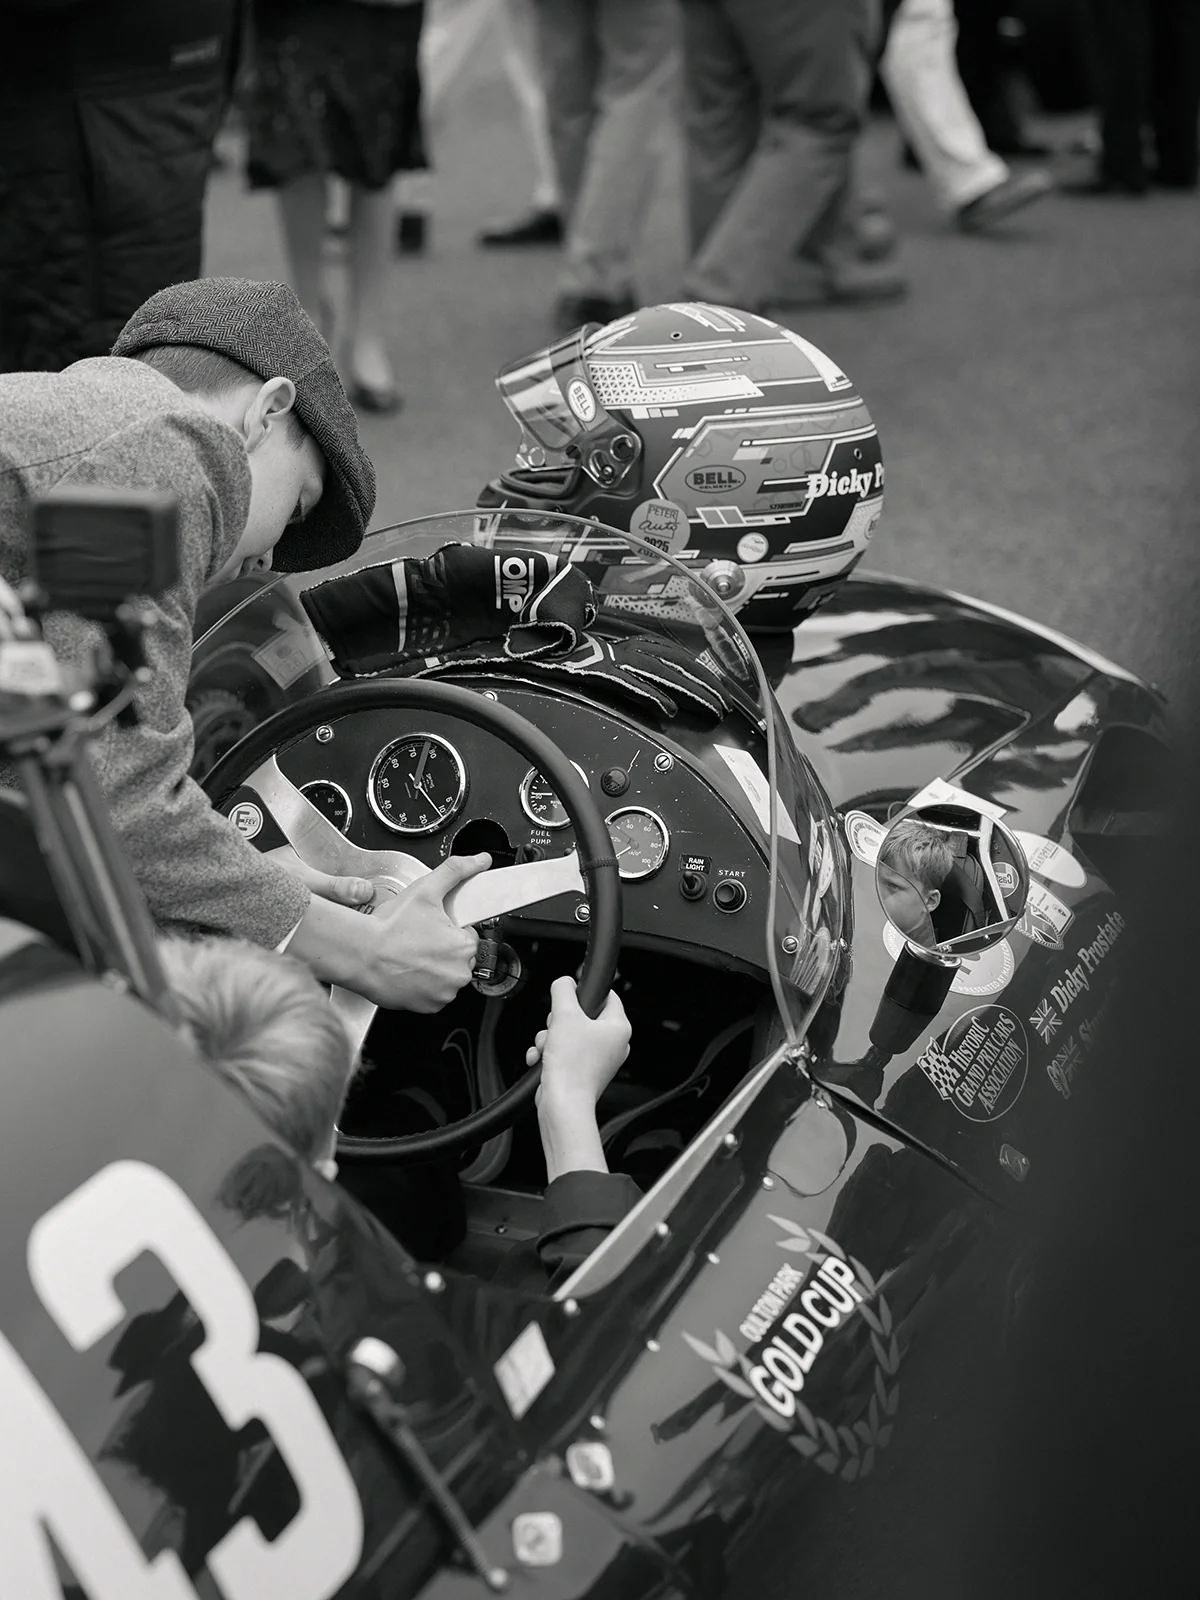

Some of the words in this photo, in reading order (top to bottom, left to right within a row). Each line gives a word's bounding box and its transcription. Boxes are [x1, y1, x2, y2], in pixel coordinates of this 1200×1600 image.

[573, 386, 590, 415] BELL
[805, 468, 873, 498] Dicky
[650, 504, 677, 519] PETER
[502, 557, 527, 613] OMP
[408, 747, 417, 758] 70
[428, 748, 437, 759] 80
[391, 758, 399, 769] 60
[381, 778, 390, 788] 50
[384, 799, 392, 810] 40
[438, 804, 446, 813] 10
[399, 812, 407, 823] 30
[419, 814, 428, 825] 20
[530, 829, 551, 837] FUEL
[688, 857, 704, 865] RAIN
[685, 863, 705, 871] LIGHT
[718, 869, 746, 877] START
[1050, 963, 1090, 1014] Dicky
[1077, 911, 1125, 974] Prostate
[949, 1016, 990, 1072] HISTORIC
[954, 1064, 986, 1107] GRAND
[976, 1038, 1001, 1071] PRIX
[990, 1012, 1016, 1047] CARS
[978, 1038, 1025, 1115] ASSOCIATION
[768, 1262, 804, 1300] PARK
[750, 1312, 823, 1418] GOLD
[801, 1256, 863, 1328] CUP
